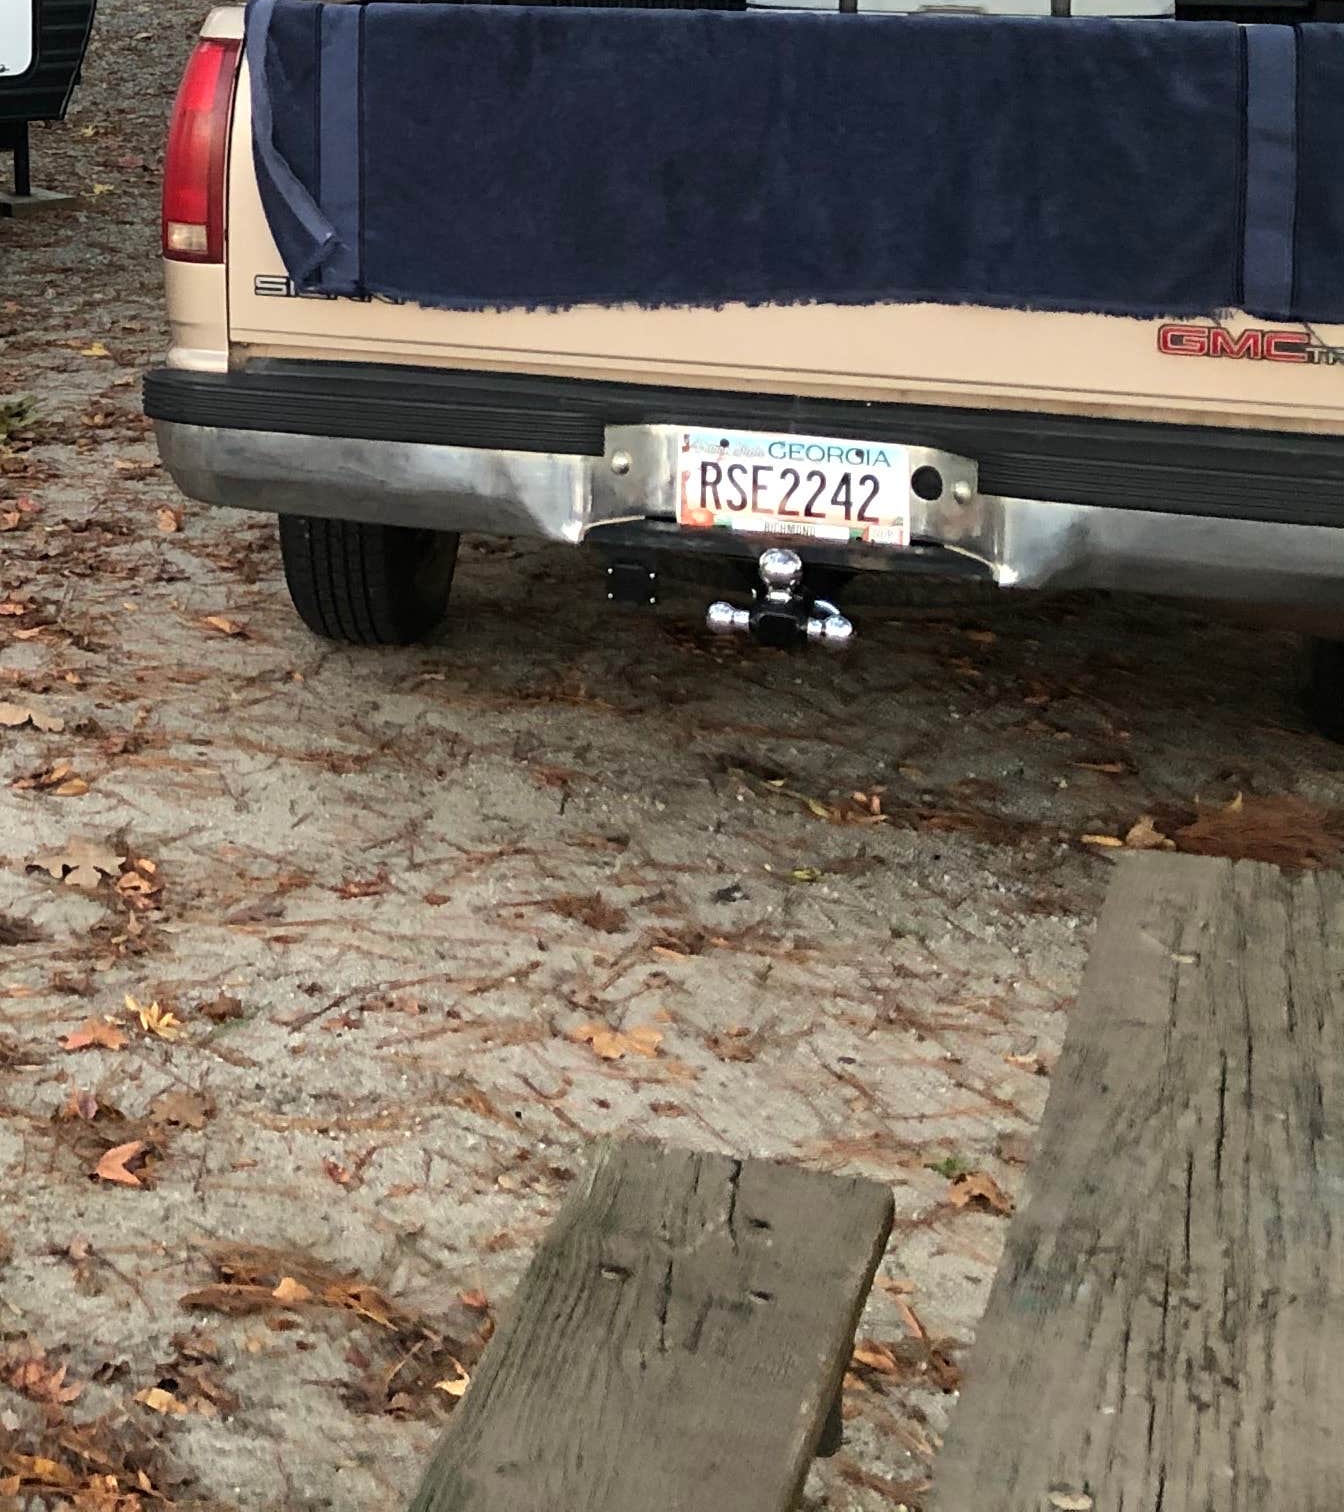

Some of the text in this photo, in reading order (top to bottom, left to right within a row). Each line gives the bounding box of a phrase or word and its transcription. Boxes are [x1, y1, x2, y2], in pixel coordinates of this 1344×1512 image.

[1158, 324, 1311, 364] GMC
[768, 440, 892, 468] GEORGIA
[700, 461, 881, 523] RSE2242
